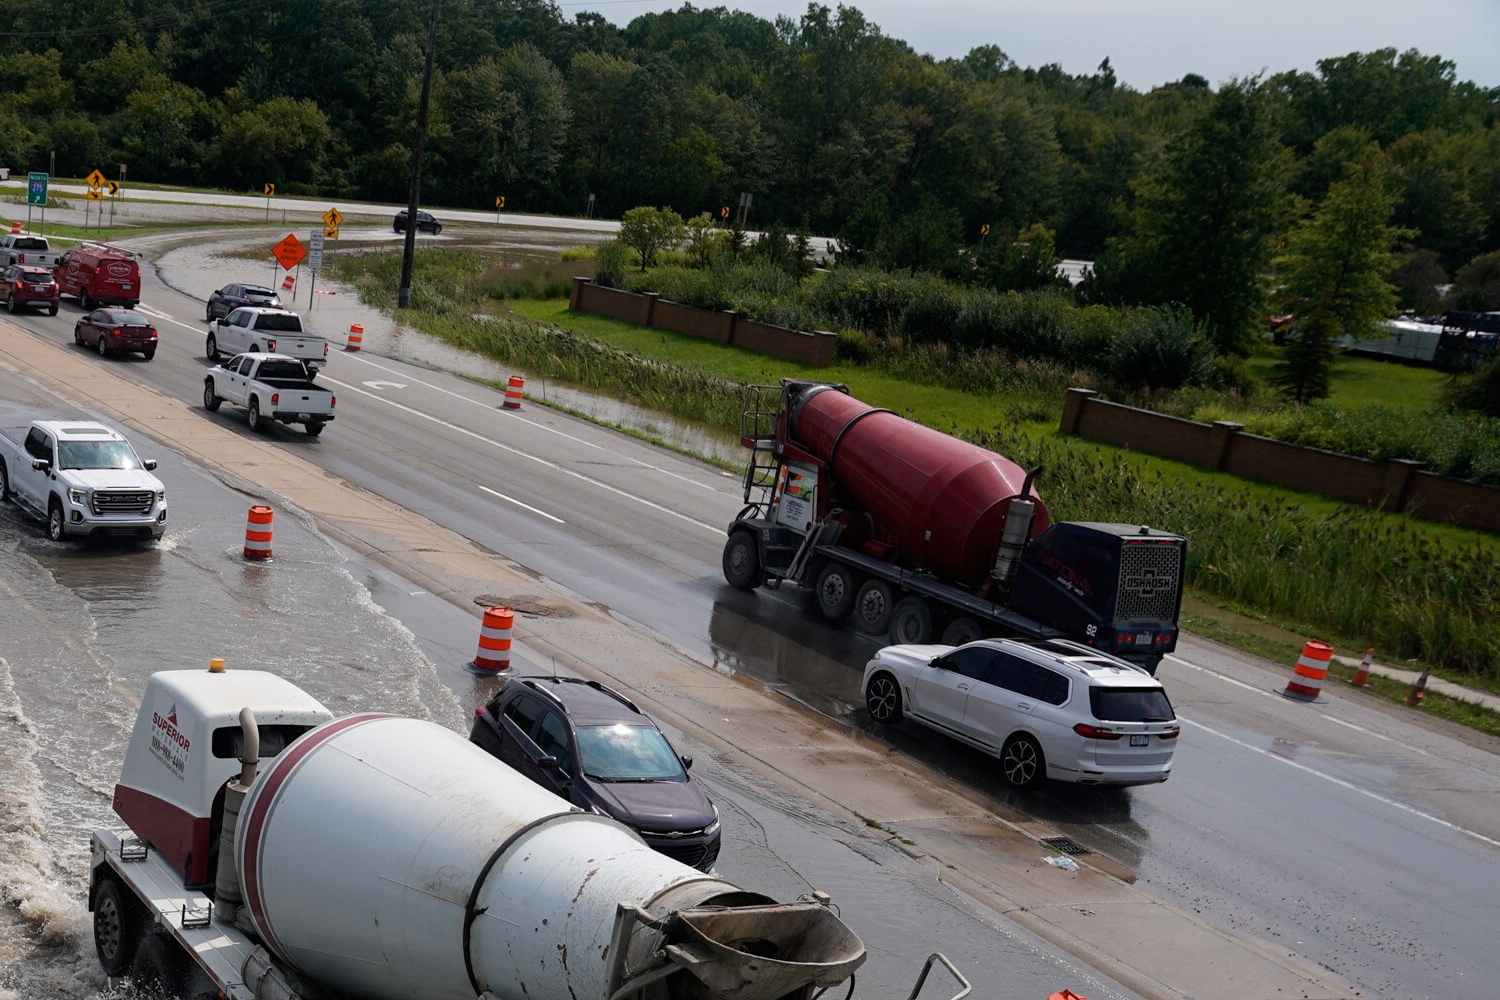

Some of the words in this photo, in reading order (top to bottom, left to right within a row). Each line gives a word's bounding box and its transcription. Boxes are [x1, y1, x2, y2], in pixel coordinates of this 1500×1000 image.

[32, 184, 44, 192] 275
[1037, 549, 1094, 596] NATIONAL
[1126, 576, 1172, 590] OSHKOSH
[1086, 624, 1098, 637] 92
[152, 712, 191, 752] SUPERIOR
